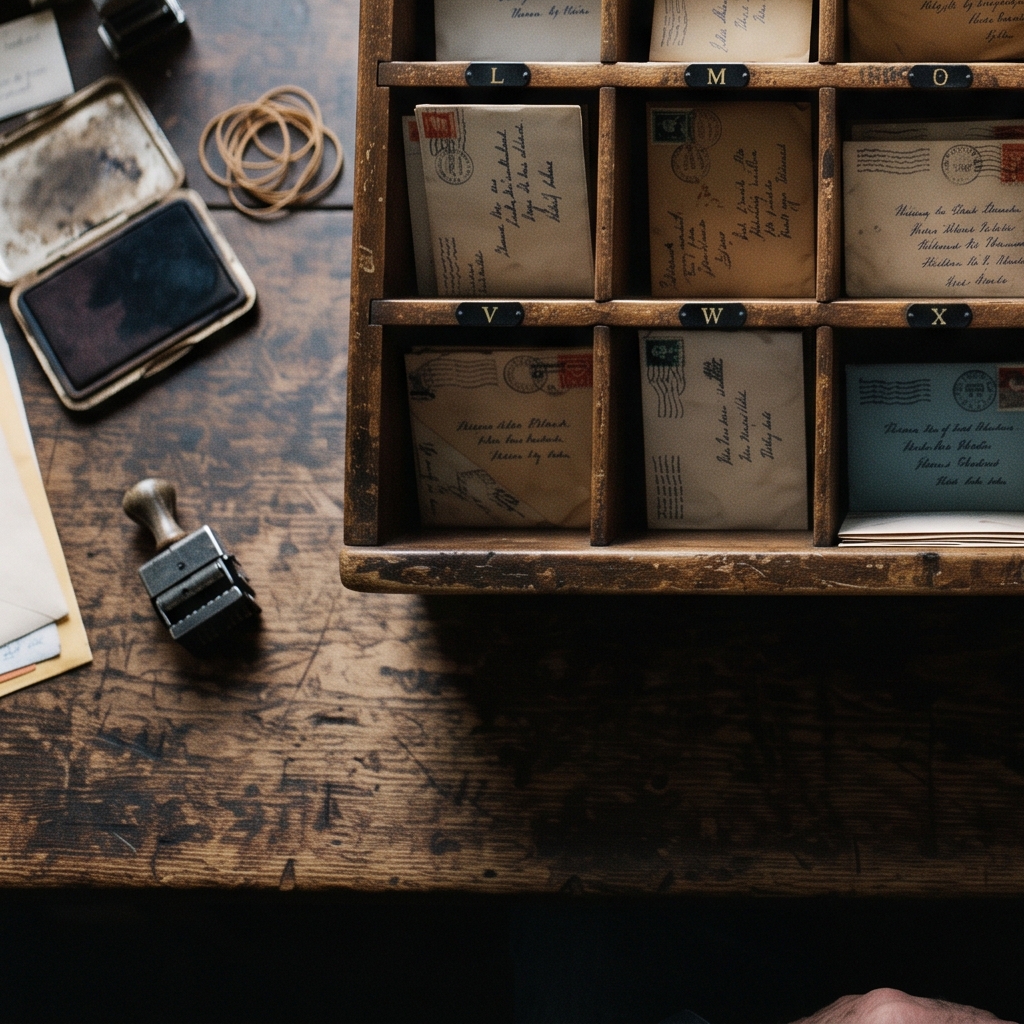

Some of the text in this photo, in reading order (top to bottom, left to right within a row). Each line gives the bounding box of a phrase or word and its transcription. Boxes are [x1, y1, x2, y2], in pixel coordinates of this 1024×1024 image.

[490, 67, 505, 84] L
[707, 67, 727, 85] M
[932, 68, 949, 86] O
[481, 306, 499, 324] V
[701, 307, 724, 325] W
[931, 307, 947, 326] X
